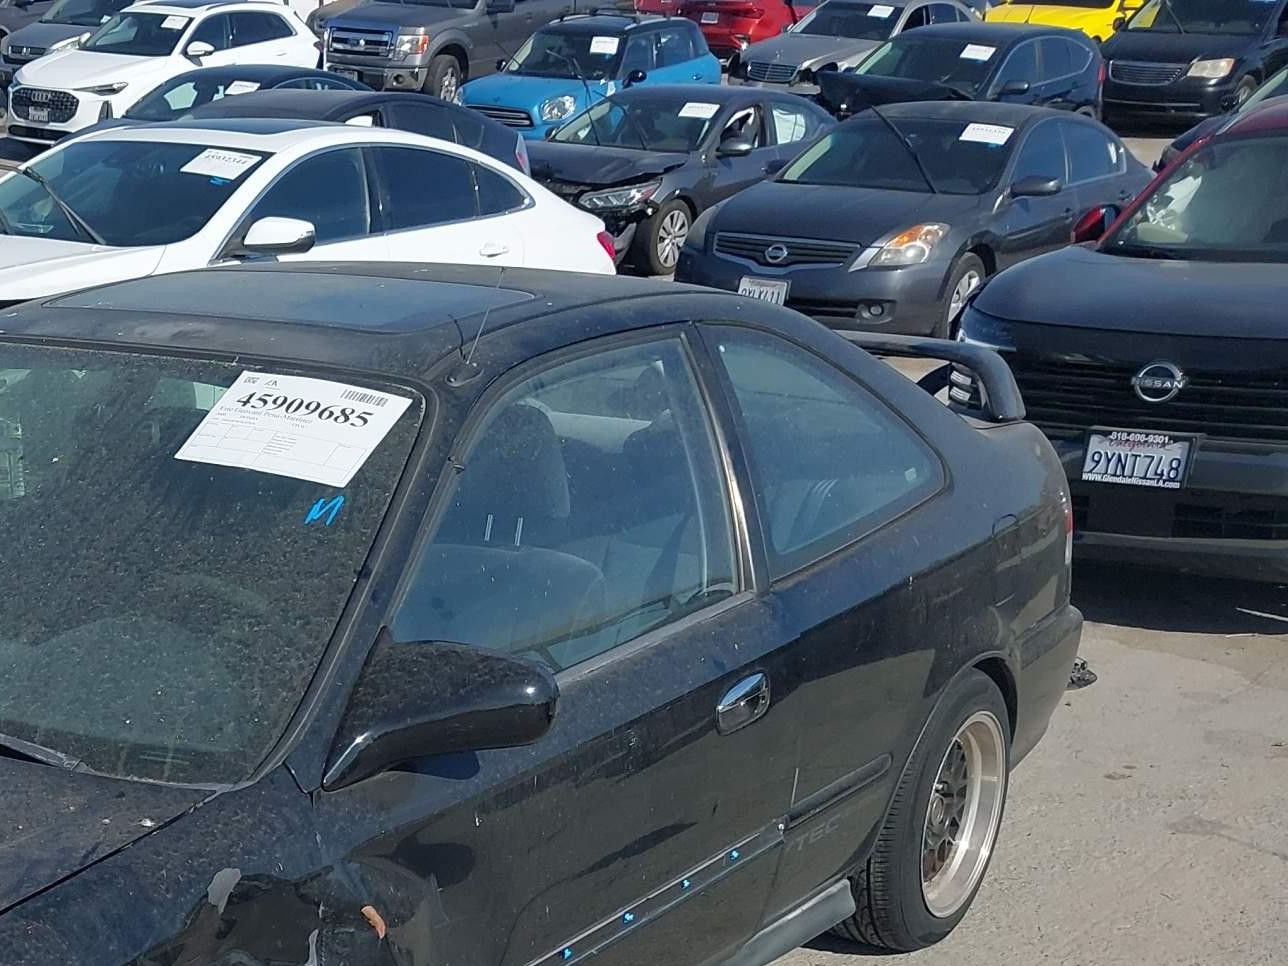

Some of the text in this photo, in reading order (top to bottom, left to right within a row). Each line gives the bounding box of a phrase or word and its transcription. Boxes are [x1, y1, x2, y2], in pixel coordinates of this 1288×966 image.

[1131, 376, 1183, 389] NISSAN
[236, 391, 374, 427] 45909685
[1086, 450, 1181, 480] 9YNT748
